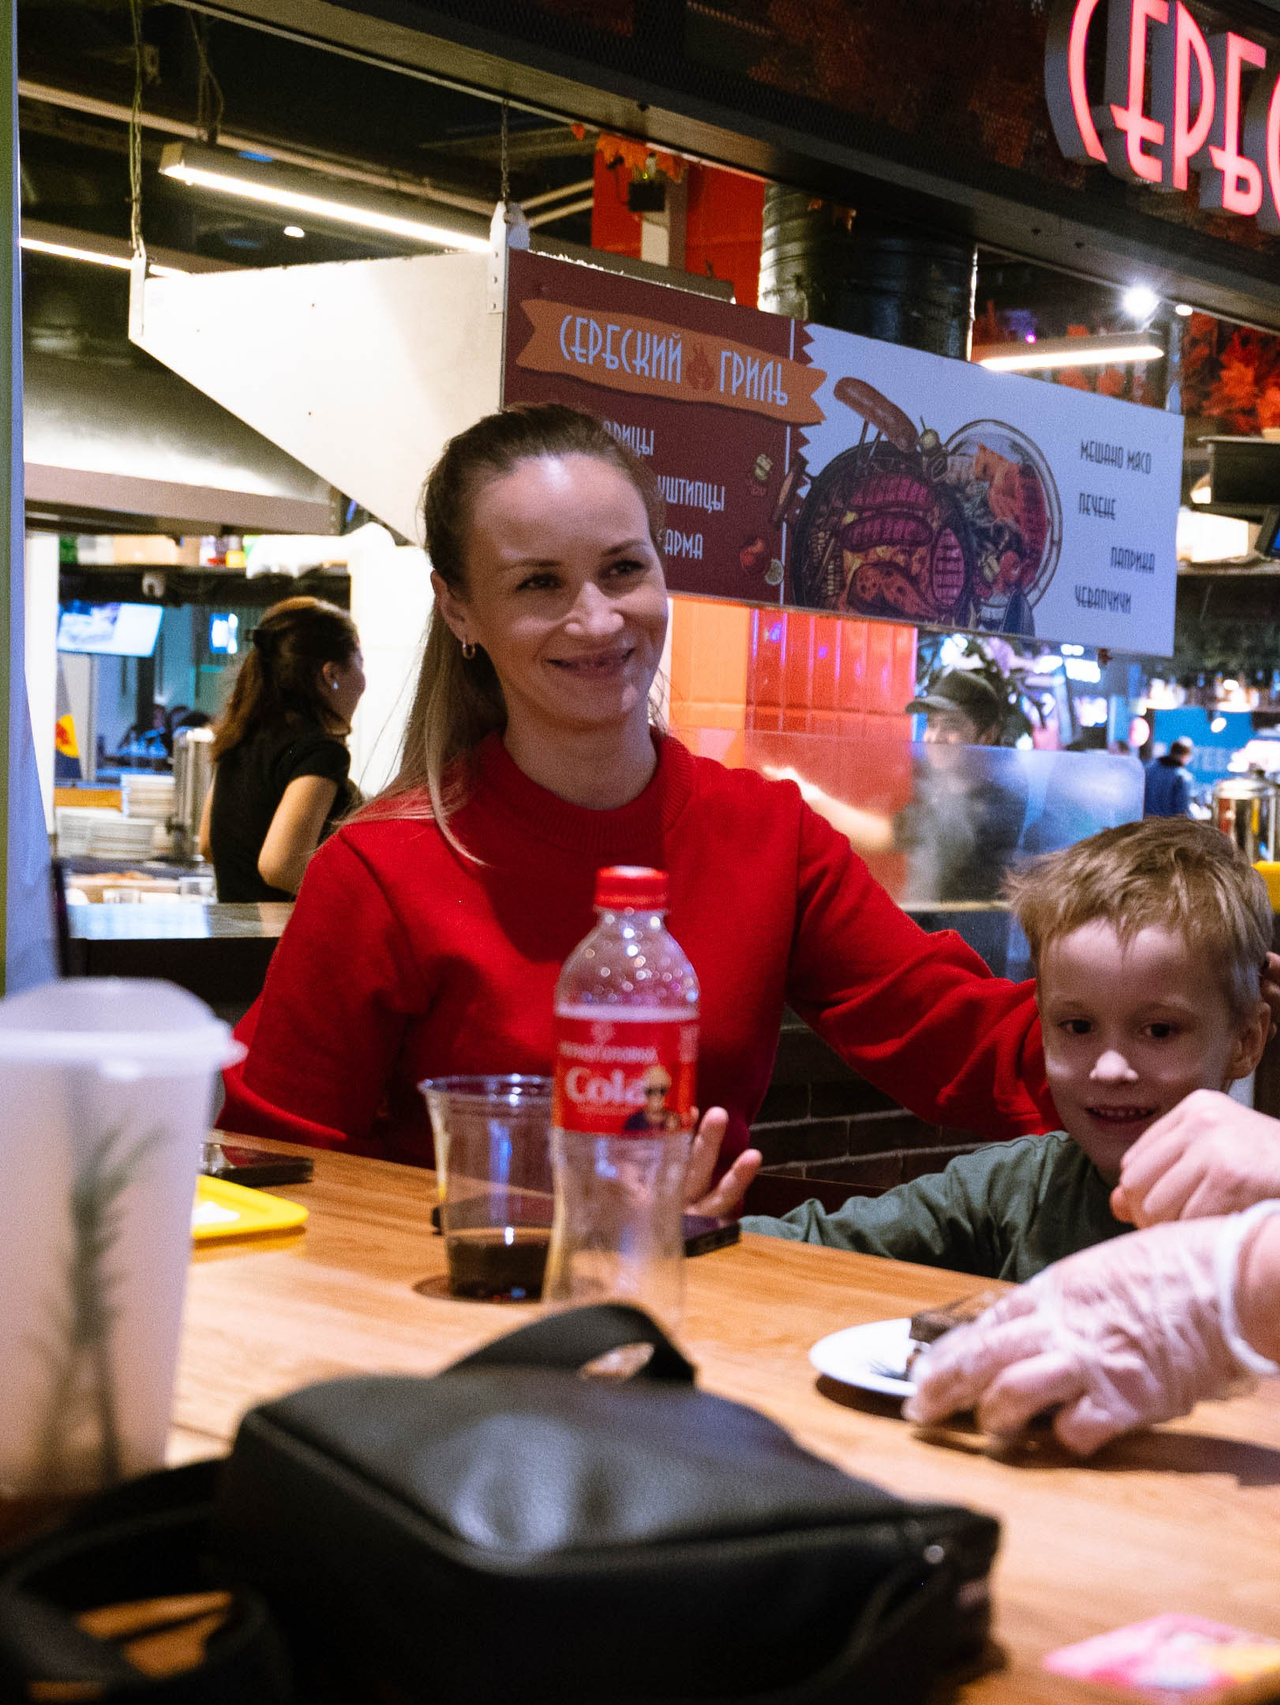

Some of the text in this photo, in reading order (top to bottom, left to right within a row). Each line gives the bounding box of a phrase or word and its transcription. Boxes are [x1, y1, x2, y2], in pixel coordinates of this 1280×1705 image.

[559, 315, 788, 406] СЕРБСКИЙ ГРИЛЬ
[1081, 440, 1152, 475] МЕШАНО МЯСО
[657, 474, 726, 514] УШТИПЦЫ
[565, 1066, 650, 1105] Cola
